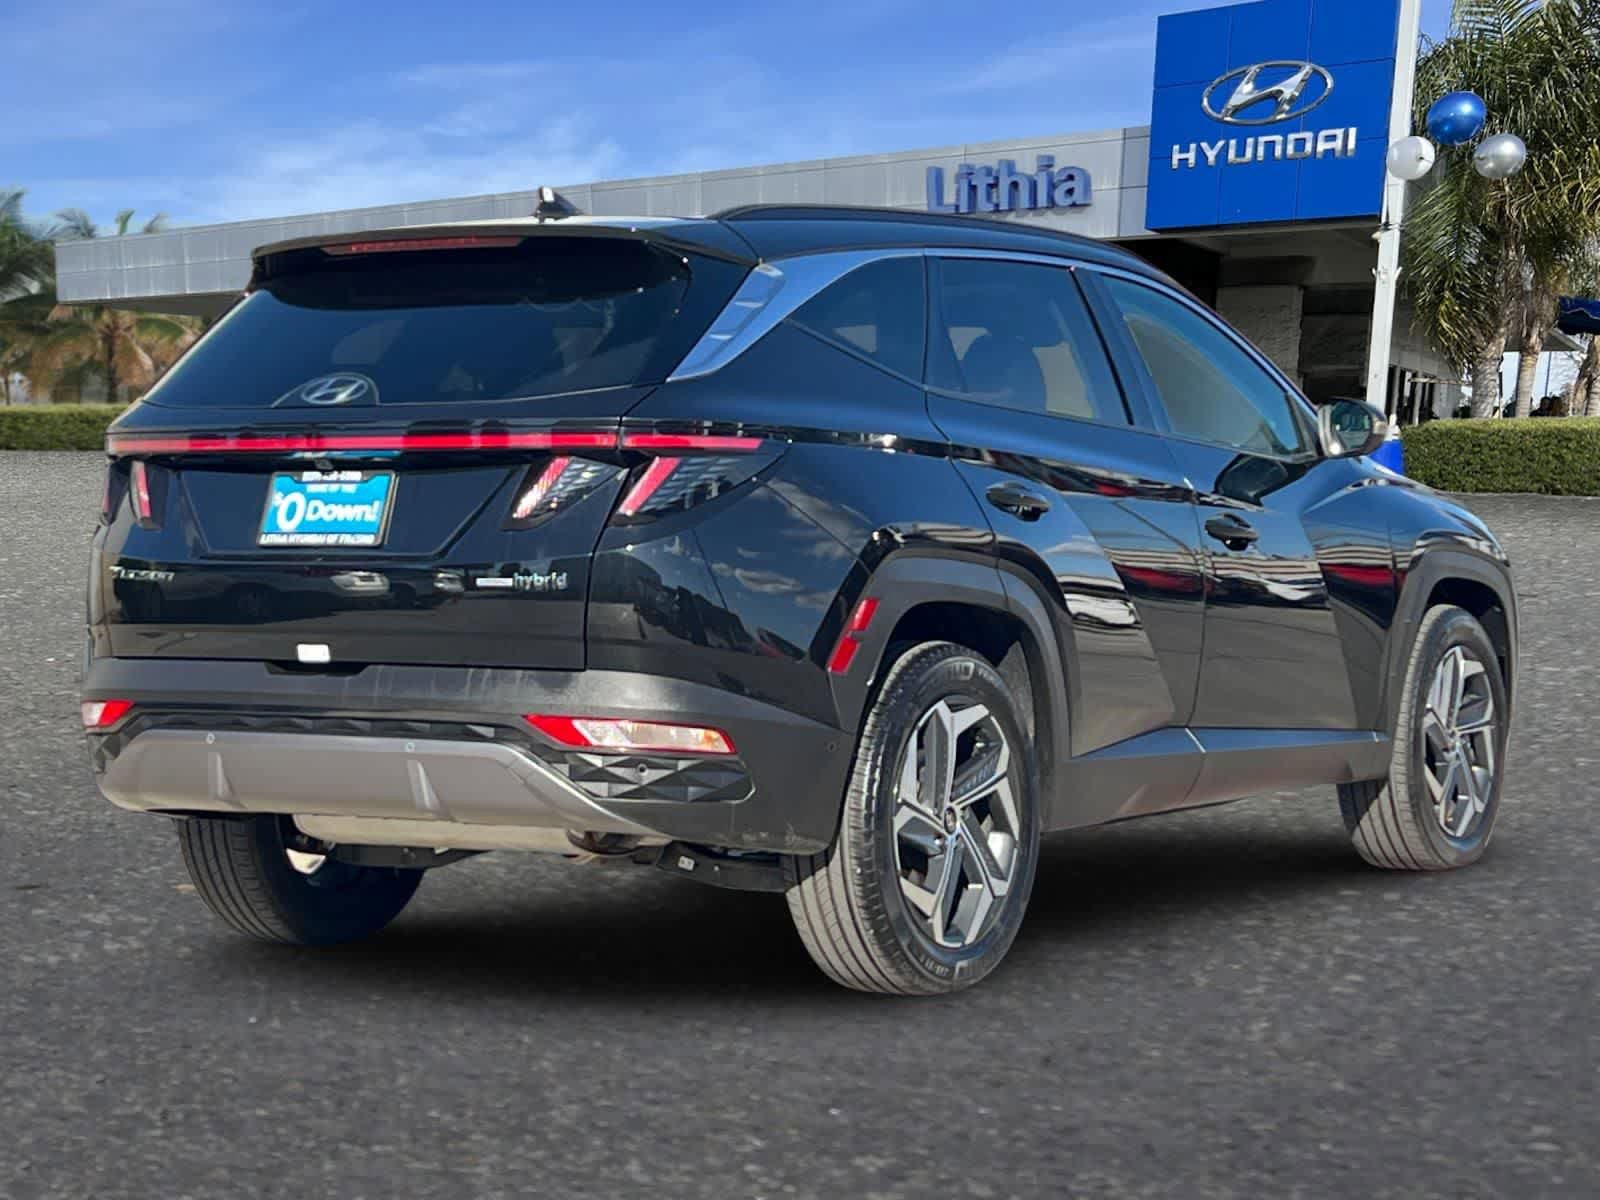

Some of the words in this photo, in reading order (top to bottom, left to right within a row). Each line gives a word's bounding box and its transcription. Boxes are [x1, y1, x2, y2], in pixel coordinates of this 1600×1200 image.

[1171, 127, 1357, 169] HYUNDAI
[926, 155, 1092, 214] Lithia
[305, 500, 381, 522] Down!
[513, 572, 568, 590] hybrid
